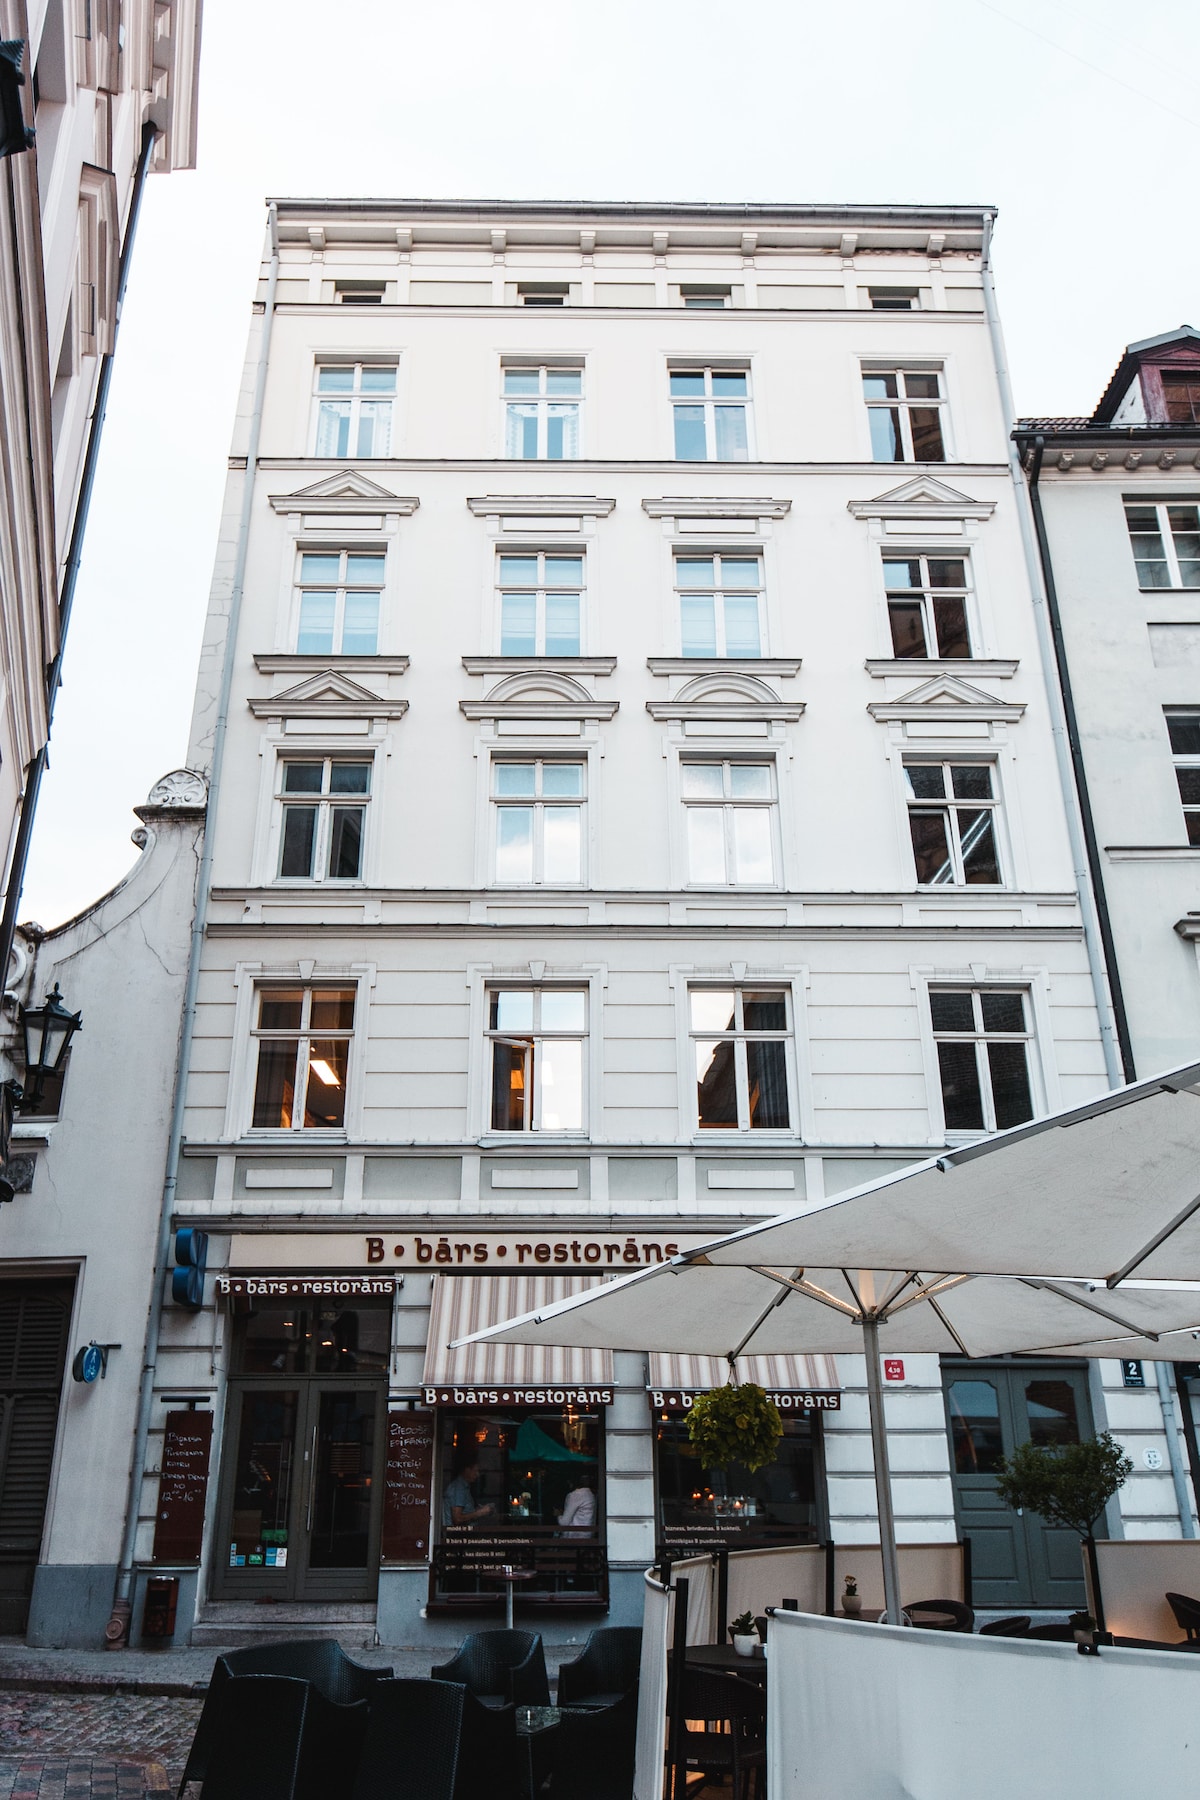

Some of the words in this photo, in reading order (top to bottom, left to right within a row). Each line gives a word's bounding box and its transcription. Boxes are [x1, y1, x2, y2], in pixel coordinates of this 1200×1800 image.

[366, 1237, 385, 1263] B
[414, 1237, 489, 1263] bārs
[515, 1238, 679, 1263] restorāns
[220, 1279, 231, 1294] B
[246, 1279, 288, 1294] bārs
[302, 1277, 393, 1294] restorāns
[1128, 1362, 1138, 1375] 2
[424, 1388, 437, 1404] B
[453, 1387, 498, 1404] bārs
[513, 1387, 611, 1404] restorāns
[652, 1391, 665, 1408] B
[765, 1391, 838, 1408] torāns
